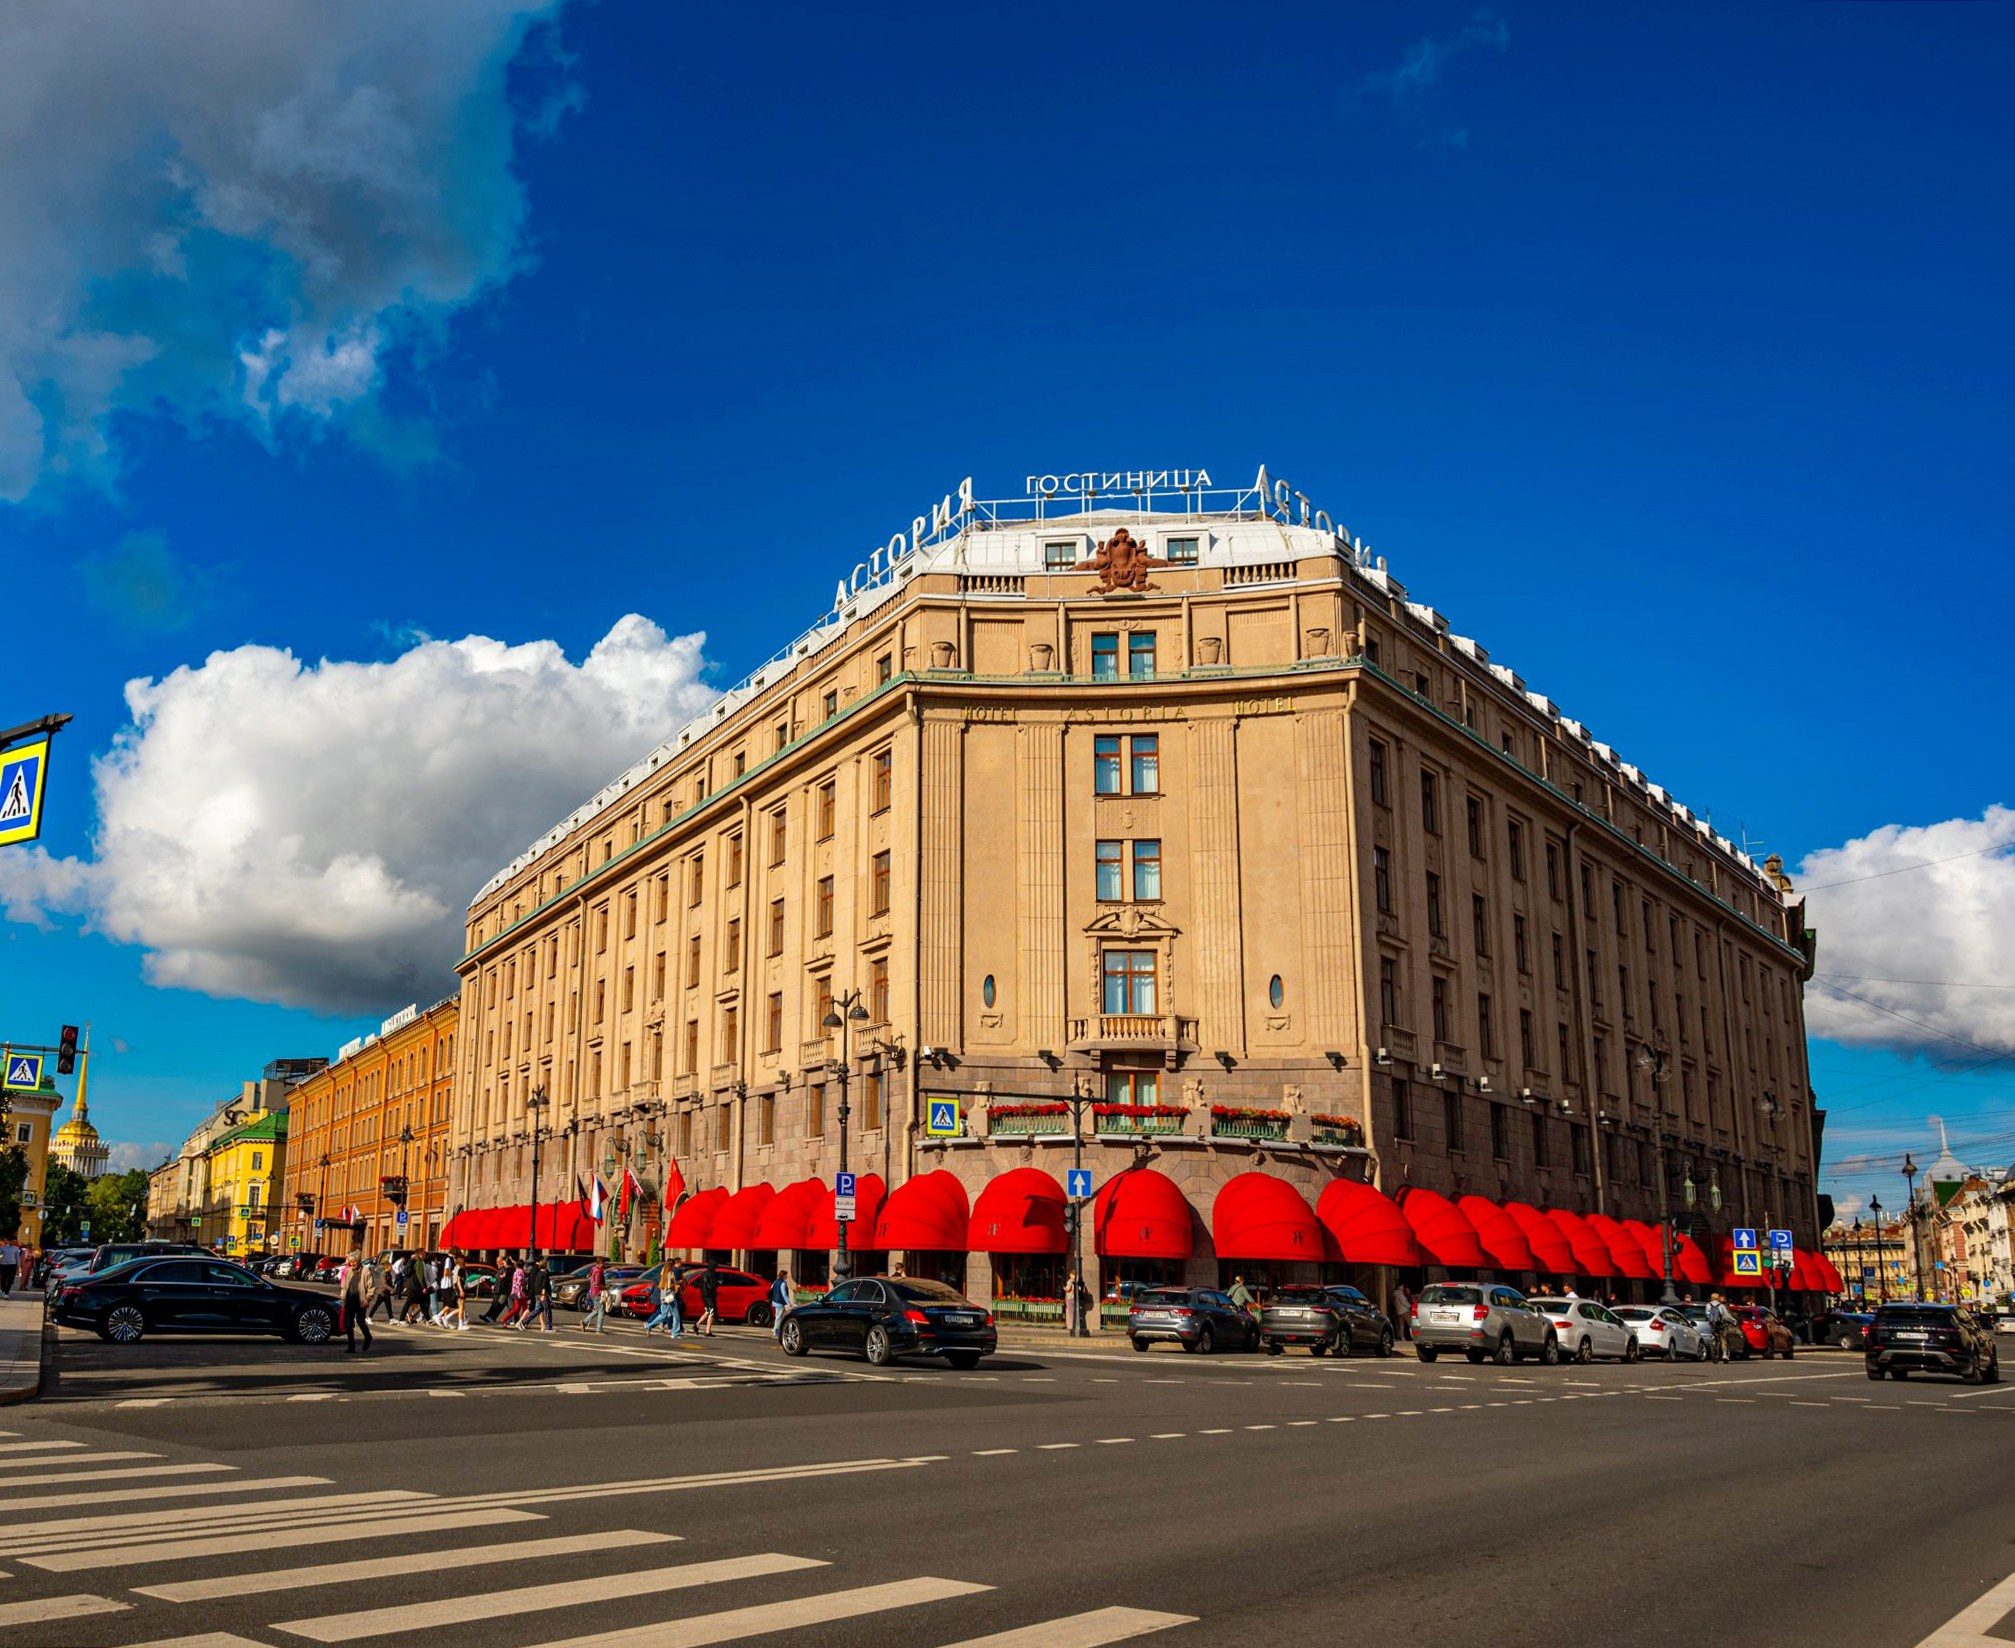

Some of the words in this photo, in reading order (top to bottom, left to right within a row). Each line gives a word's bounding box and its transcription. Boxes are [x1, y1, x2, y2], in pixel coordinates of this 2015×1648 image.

[1026, 468, 1213, 495] ГОСТИНИЦА
[832, 476, 972, 613] АСТОРИЯ
[964, 705, 1019, 721] HOTEL
[1067, 704, 1187, 722] ASTORIA
[1235, 696, 1297, 715] HOTEL
